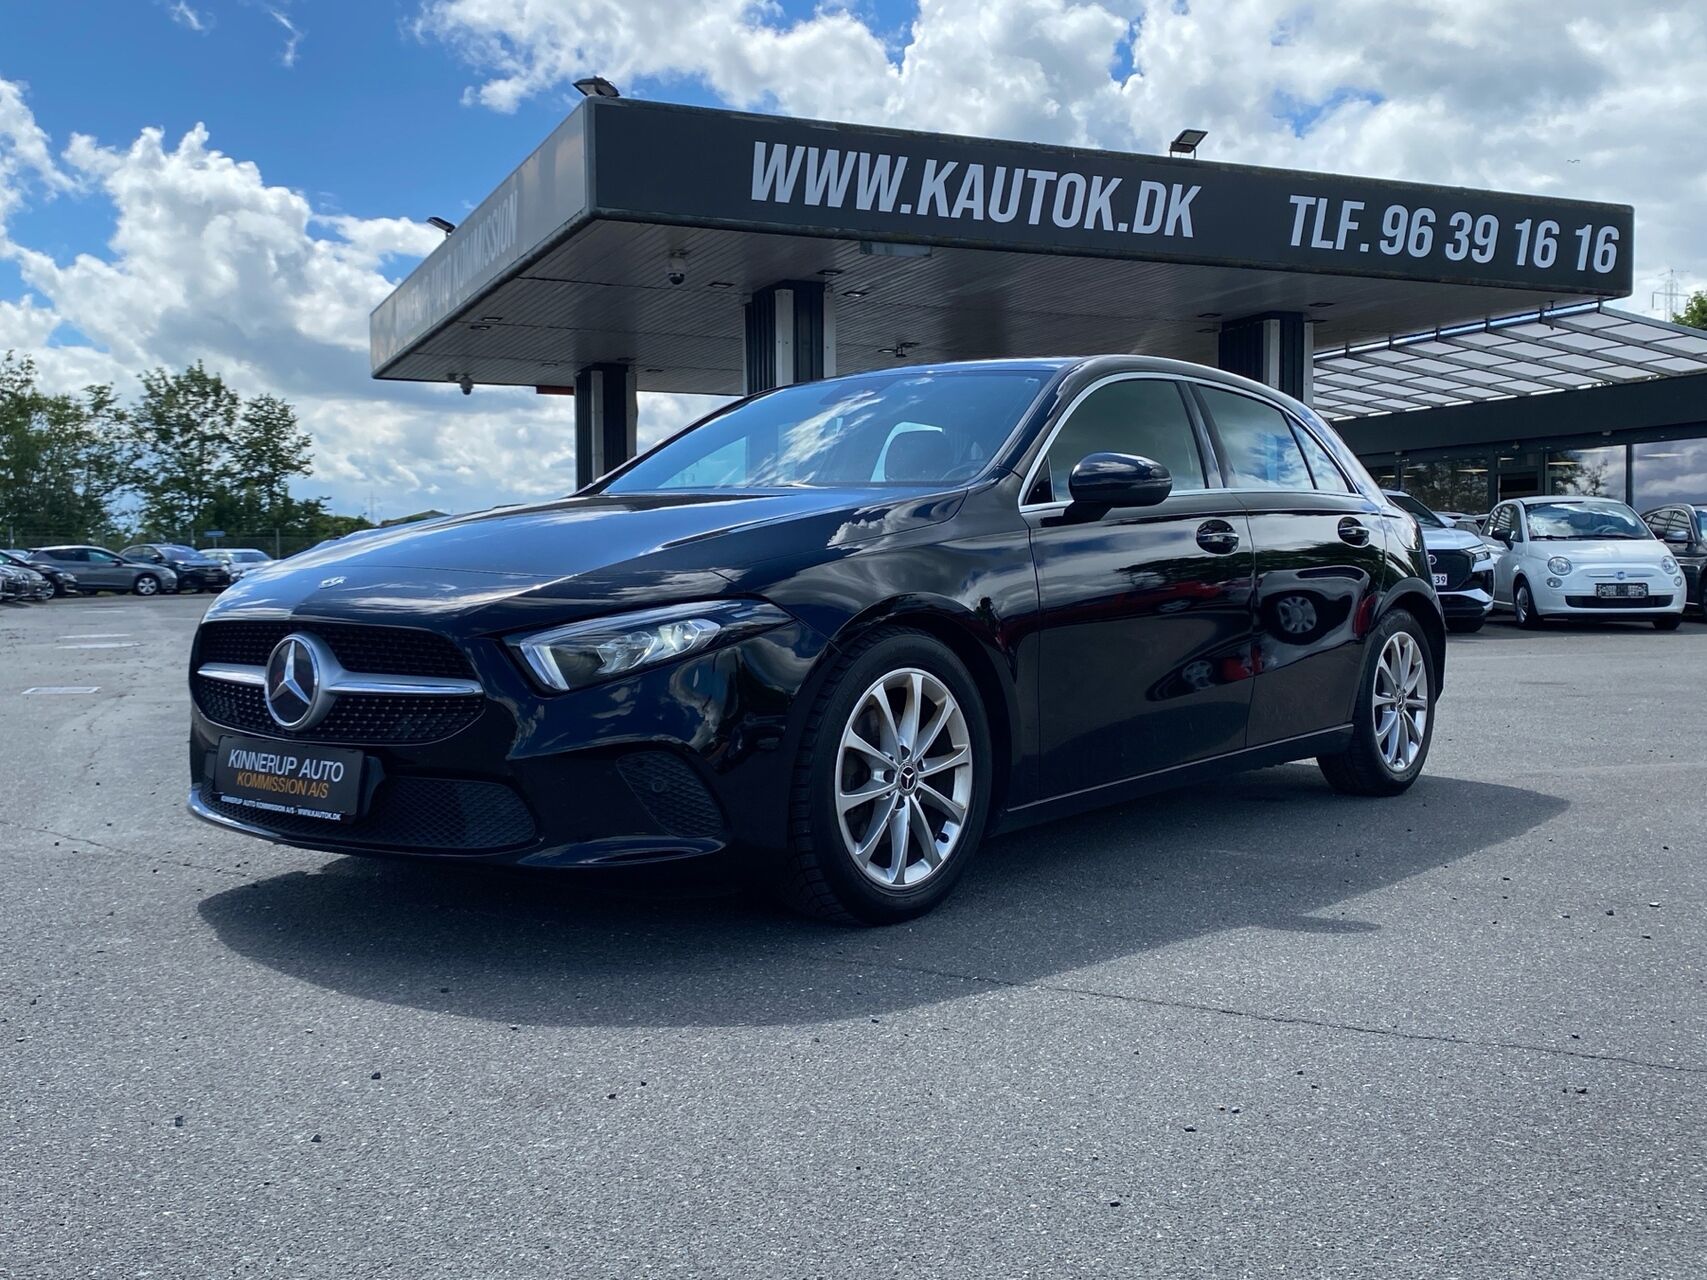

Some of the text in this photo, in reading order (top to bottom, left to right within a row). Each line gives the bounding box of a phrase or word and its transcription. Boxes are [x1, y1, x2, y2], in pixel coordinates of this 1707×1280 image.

[752, 142, 1202, 238] WWW.KAUTOK.DK
[1289, 194, 1620, 274] TLF. 96 39 16 16
[228, 749, 344, 782] KINNERUP AUTO
[236, 771, 329, 799] KOMMISSION A/S
